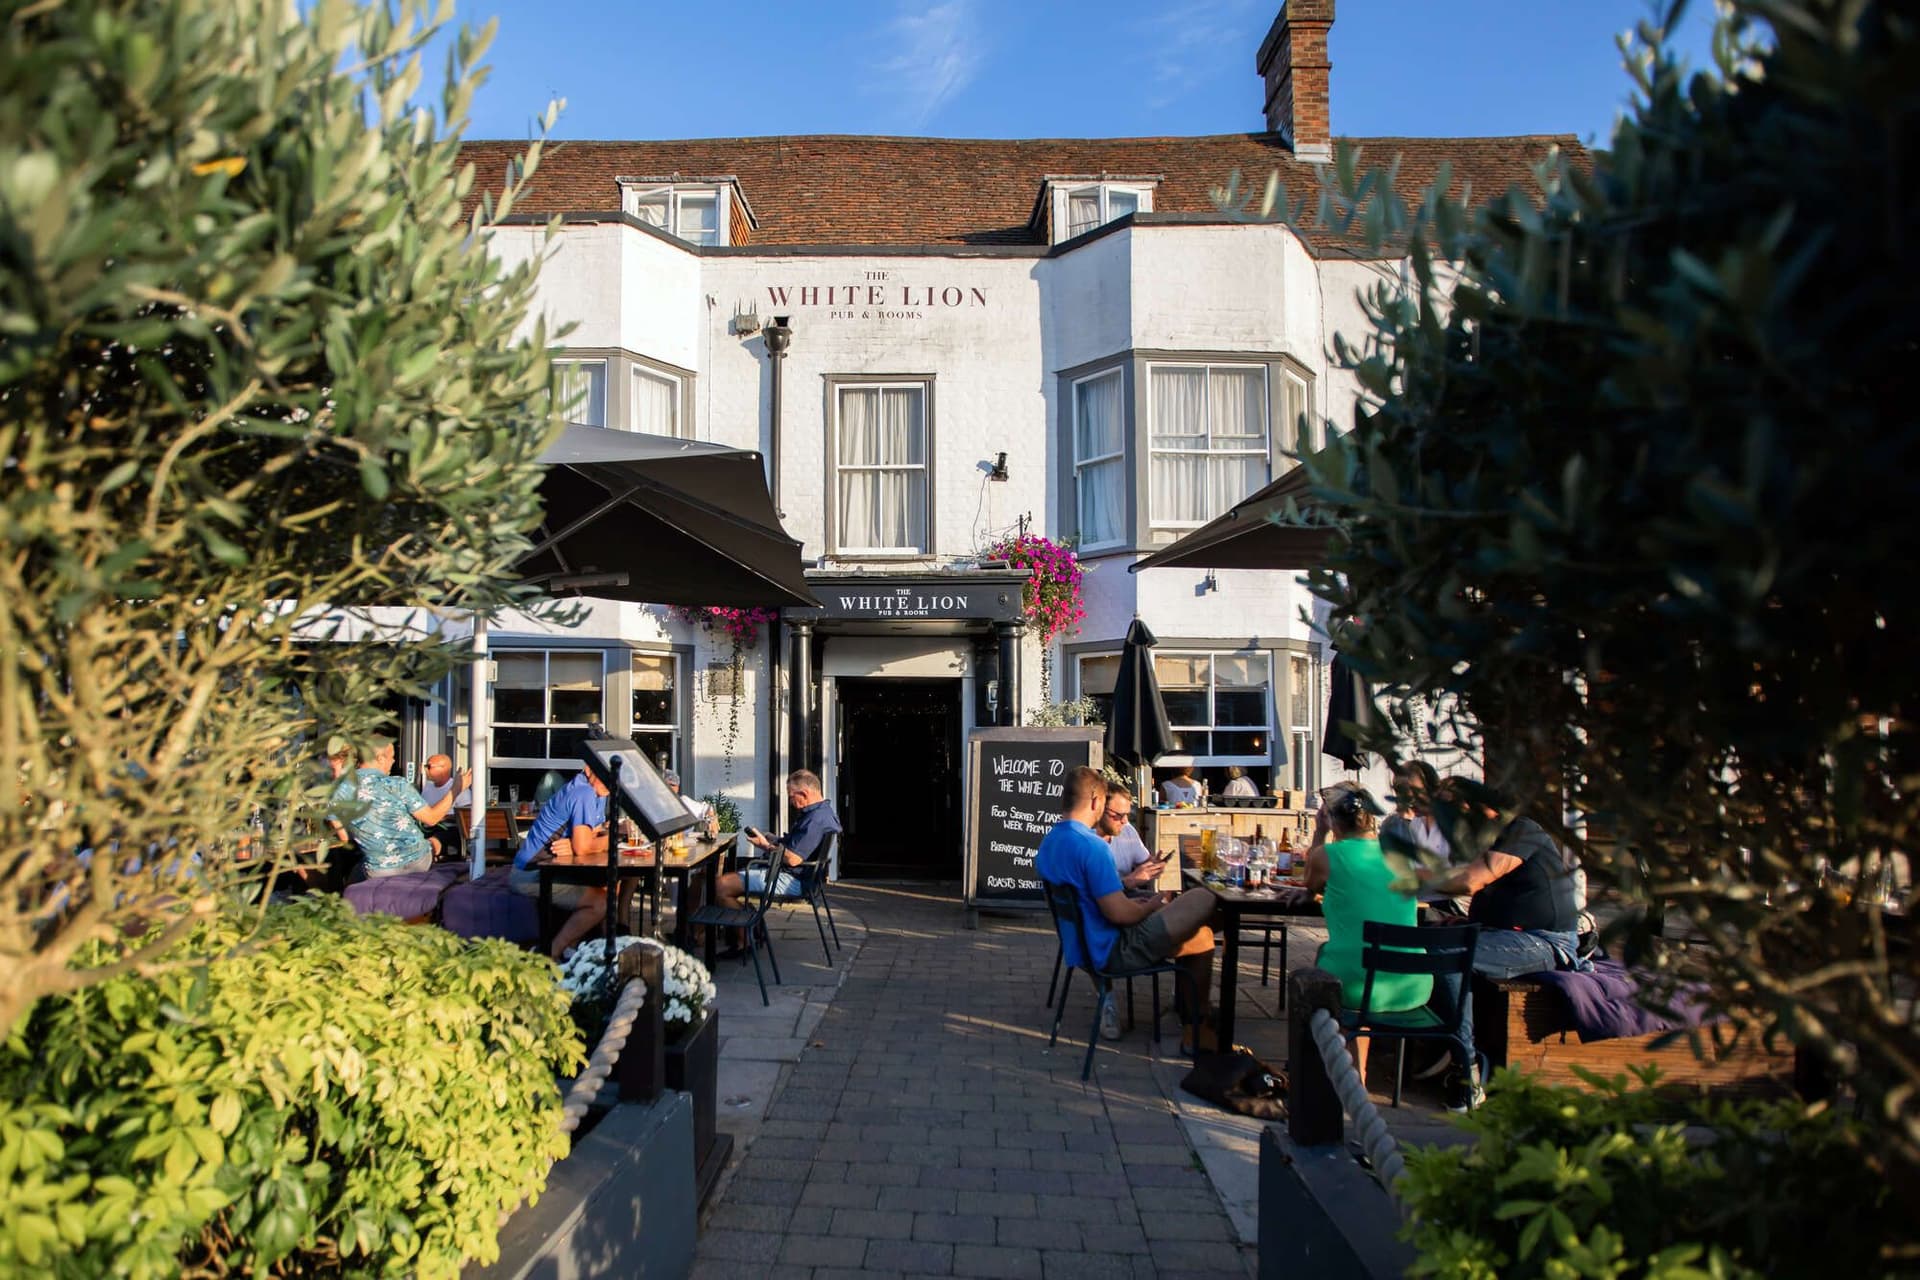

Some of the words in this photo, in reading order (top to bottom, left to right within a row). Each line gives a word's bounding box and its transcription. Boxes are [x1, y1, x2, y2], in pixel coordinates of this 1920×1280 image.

[864, 271, 889, 281] THE
[767, 286, 885, 306] WHITE
[903, 287, 988, 307] LION
[830, 311, 854, 319] PUB
[862, 311, 870, 319] &
[878, 311, 923, 319] ROOMS
[839, 596, 909, 609] WHITE
[917, 596, 969, 609] LION
[993, 755, 1040, 776] WELCOME
[1048, 759, 1064, 776] TO
[998, 779, 1014, 792] THE
[1018, 780, 1043, 795] WHITE
[991, 805, 1007, 817] FOOD
[1010, 806, 1035, 822] SERVED
[1037, 810, 1045, 821] 7
[1003, 819, 1023, 831] WEEK
[1026, 822, 1045, 834] FROM
[990, 841, 1025, 855] BREAKFAST
[1013, 856, 1033, 868] FROM
[987, 875, 1015, 889] ROASTS
[1018, 879, 1044, 889] SERVED
